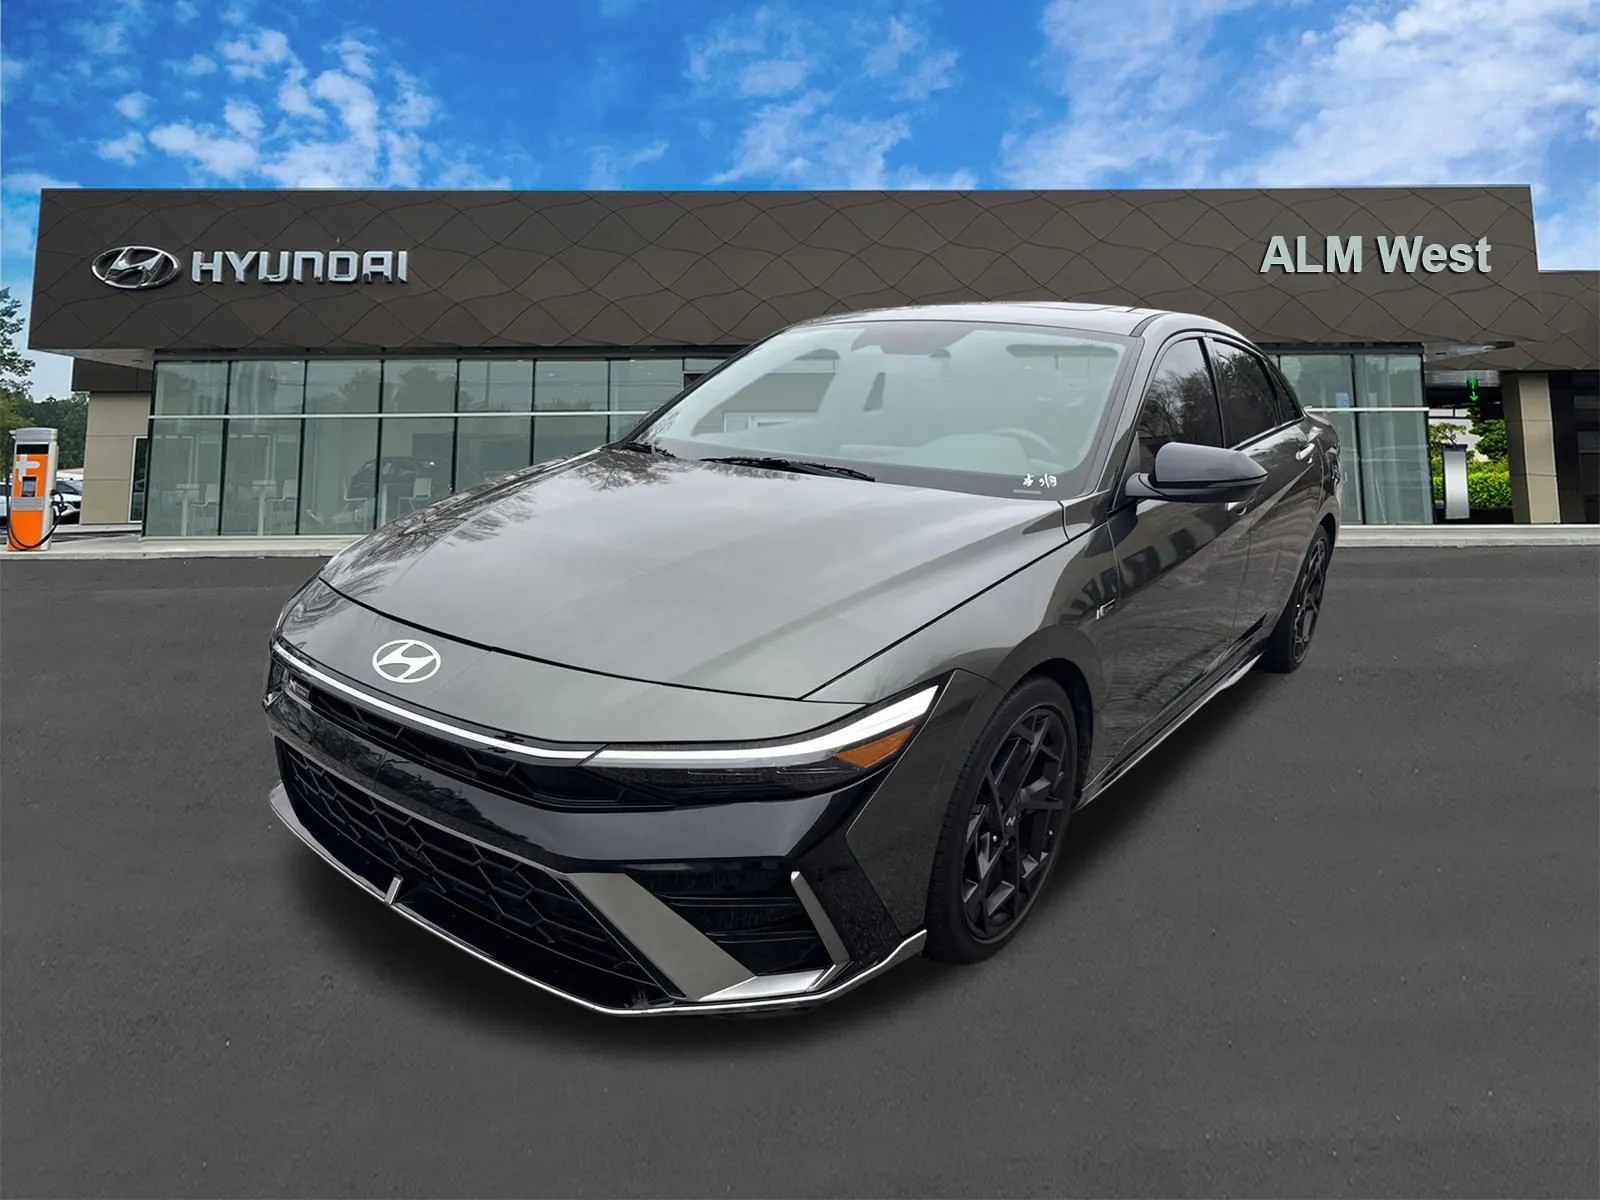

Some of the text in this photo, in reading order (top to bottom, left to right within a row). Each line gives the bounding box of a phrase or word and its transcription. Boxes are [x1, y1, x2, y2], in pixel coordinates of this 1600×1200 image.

[191, 251, 408, 283] HYUNDAI
[1259, 235, 1492, 273] ALM West
